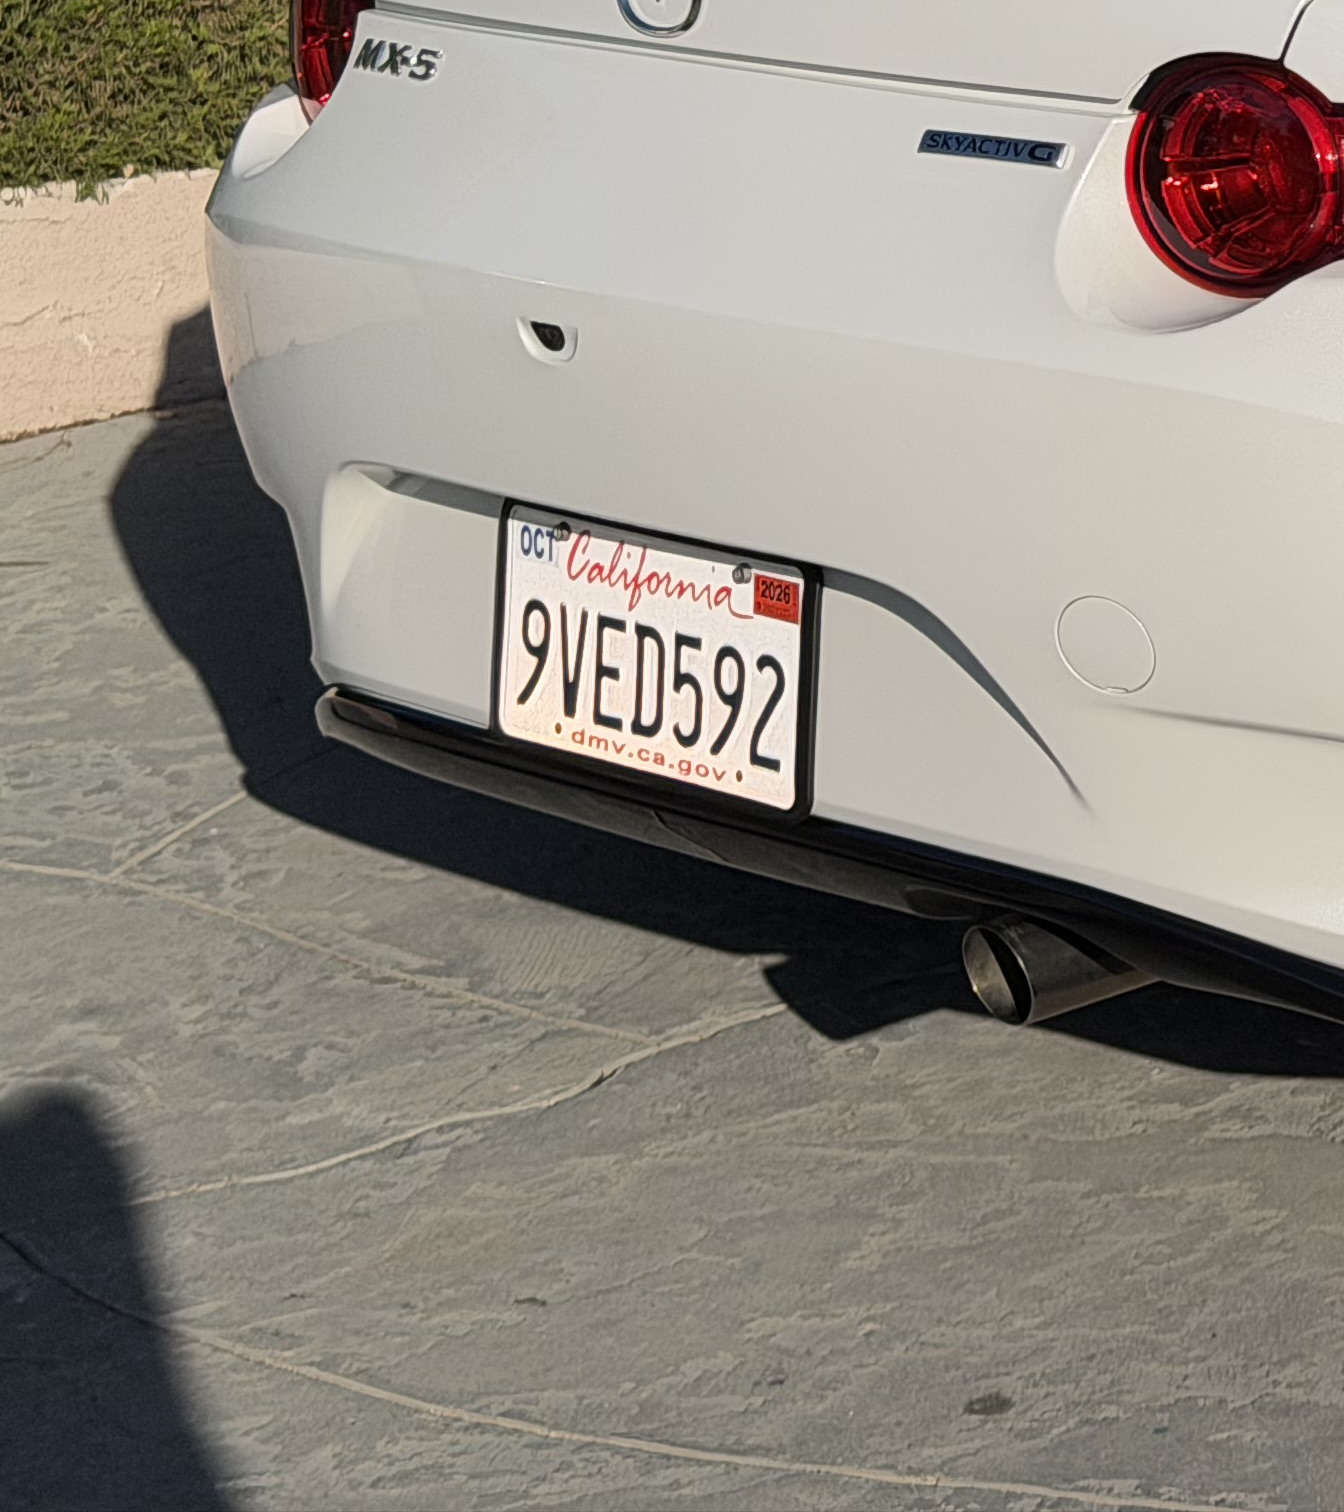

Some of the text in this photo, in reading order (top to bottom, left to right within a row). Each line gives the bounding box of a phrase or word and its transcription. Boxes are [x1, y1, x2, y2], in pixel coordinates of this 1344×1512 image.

[353, 38, 444, 80] MX-5
[520, 524, 555, 562] OCT
[567, 530, 754, 619] California
[760, 579, 791, 605] 2026
[516, 599, 786, 773] 9VED592
[571, 728, 727, 782] dmv.ca.gov
